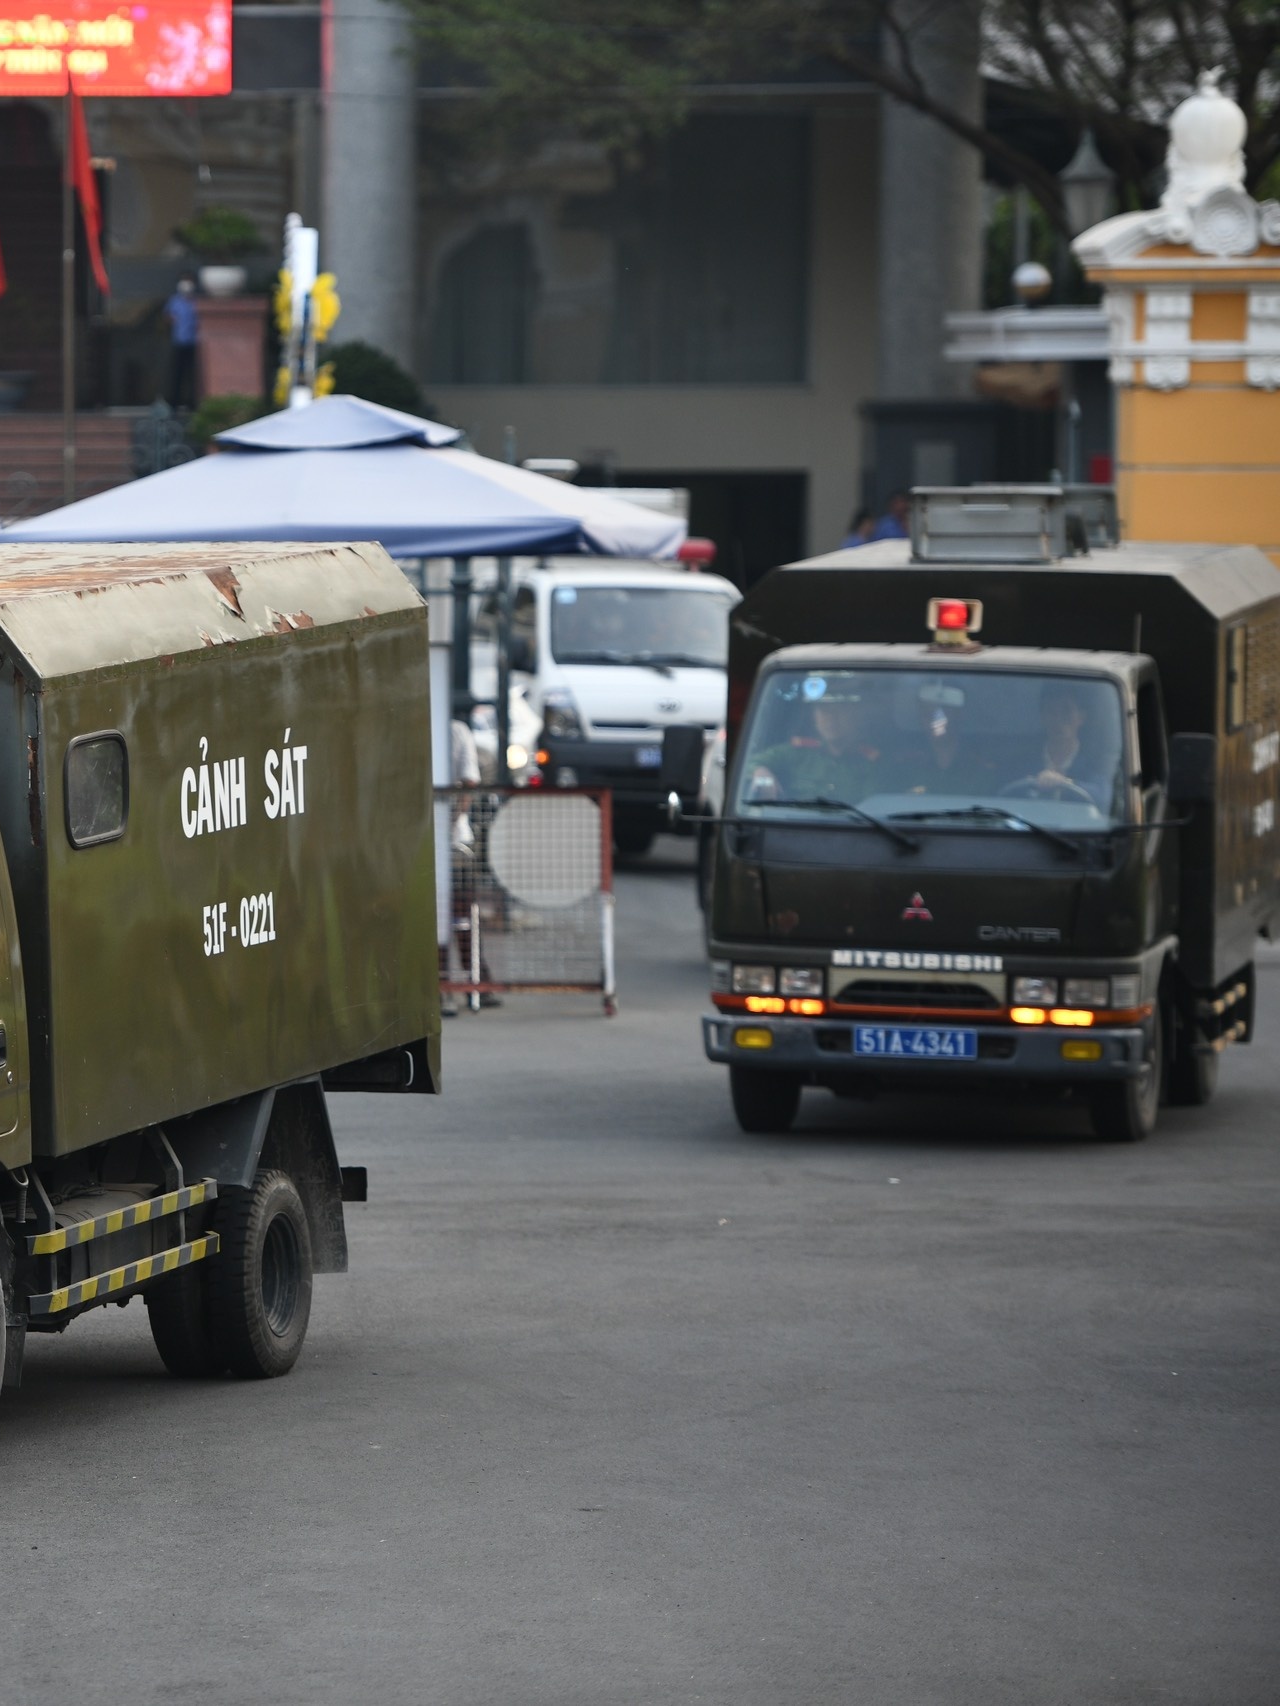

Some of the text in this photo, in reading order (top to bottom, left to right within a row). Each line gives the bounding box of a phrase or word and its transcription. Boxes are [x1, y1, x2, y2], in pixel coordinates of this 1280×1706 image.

[180, 727, 308, 838] CẢNH SÁT
[978, 925, 1061, 943] CANTER
[831, 949, 1003, 972] MITSUBISHI
[860, 1028, 966, 1056] 51A-4341
